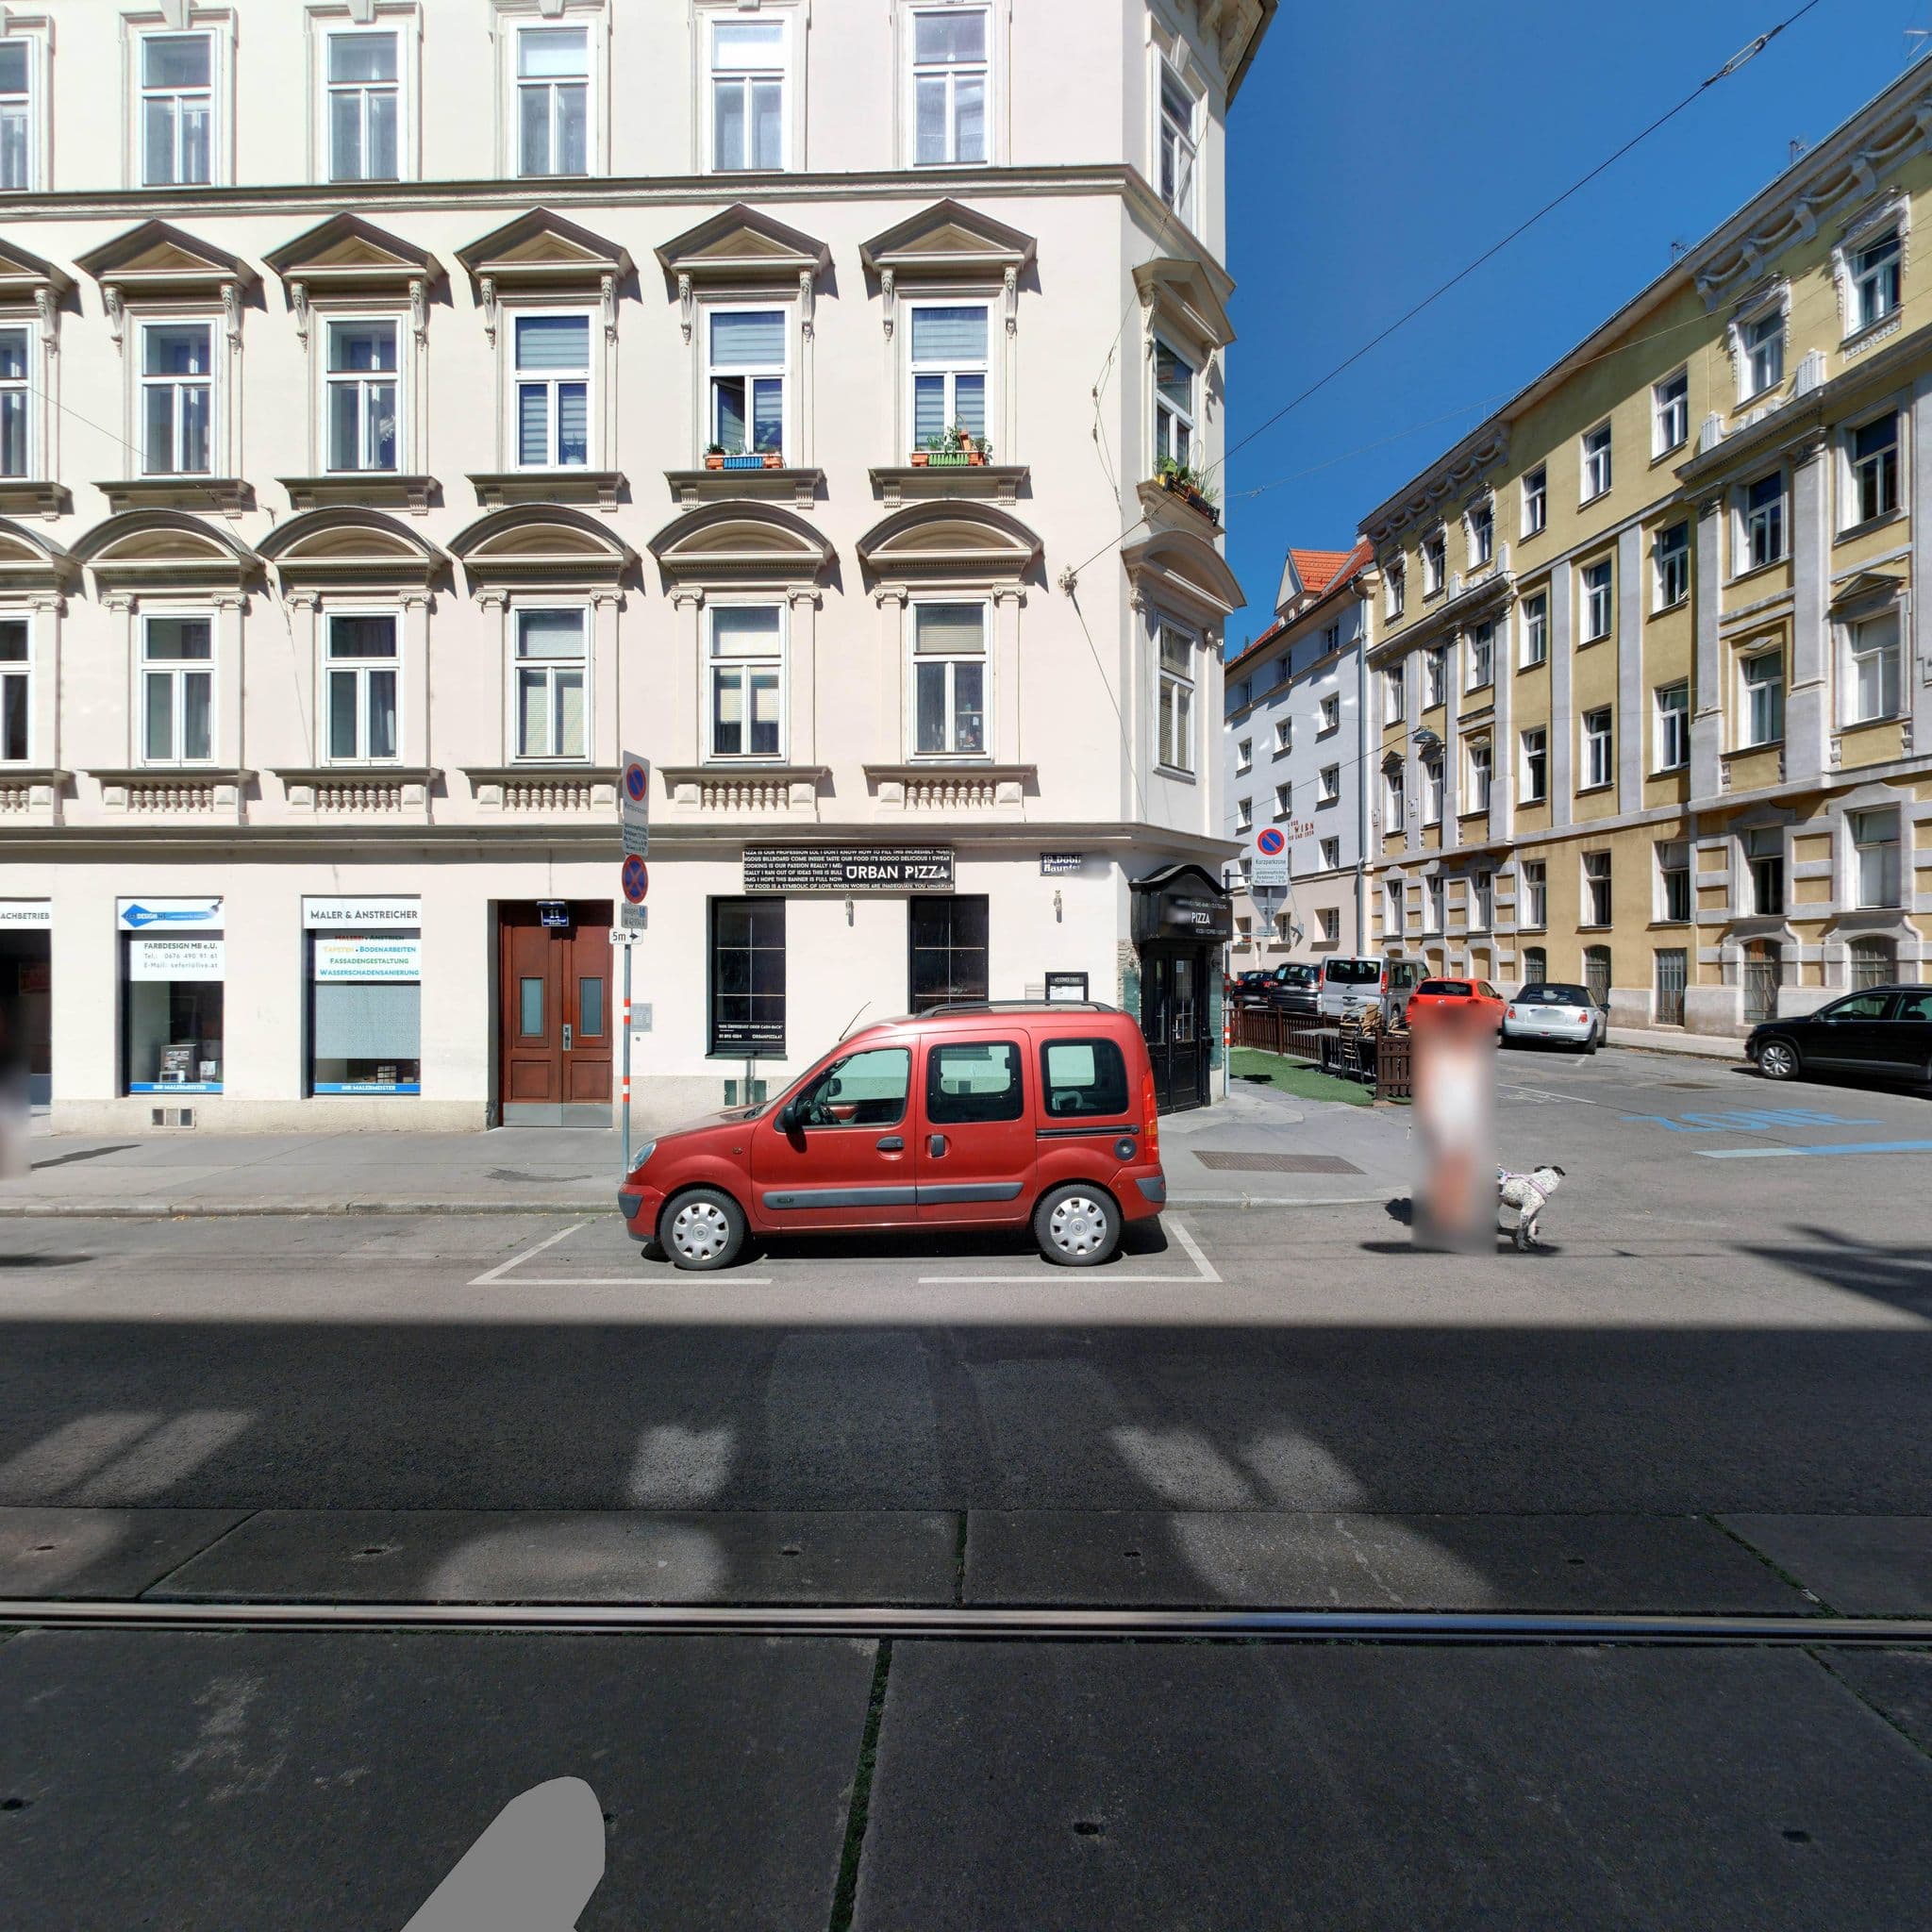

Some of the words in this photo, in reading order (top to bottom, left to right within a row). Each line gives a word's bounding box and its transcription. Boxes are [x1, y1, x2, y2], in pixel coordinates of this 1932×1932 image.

[846, 866, 899, 879] URBAN
[905, 866, 947, 879] PIZZA
[310, 910, 343, 919] MALER
[346, 910, 352, 919] &
[355, 909, 418, 919] ANSTREICHER
[549, 909, 560, 918] 11
[1191, 912, 1210, 924] PIZZA
[613, 932, 626, 941] 5m
